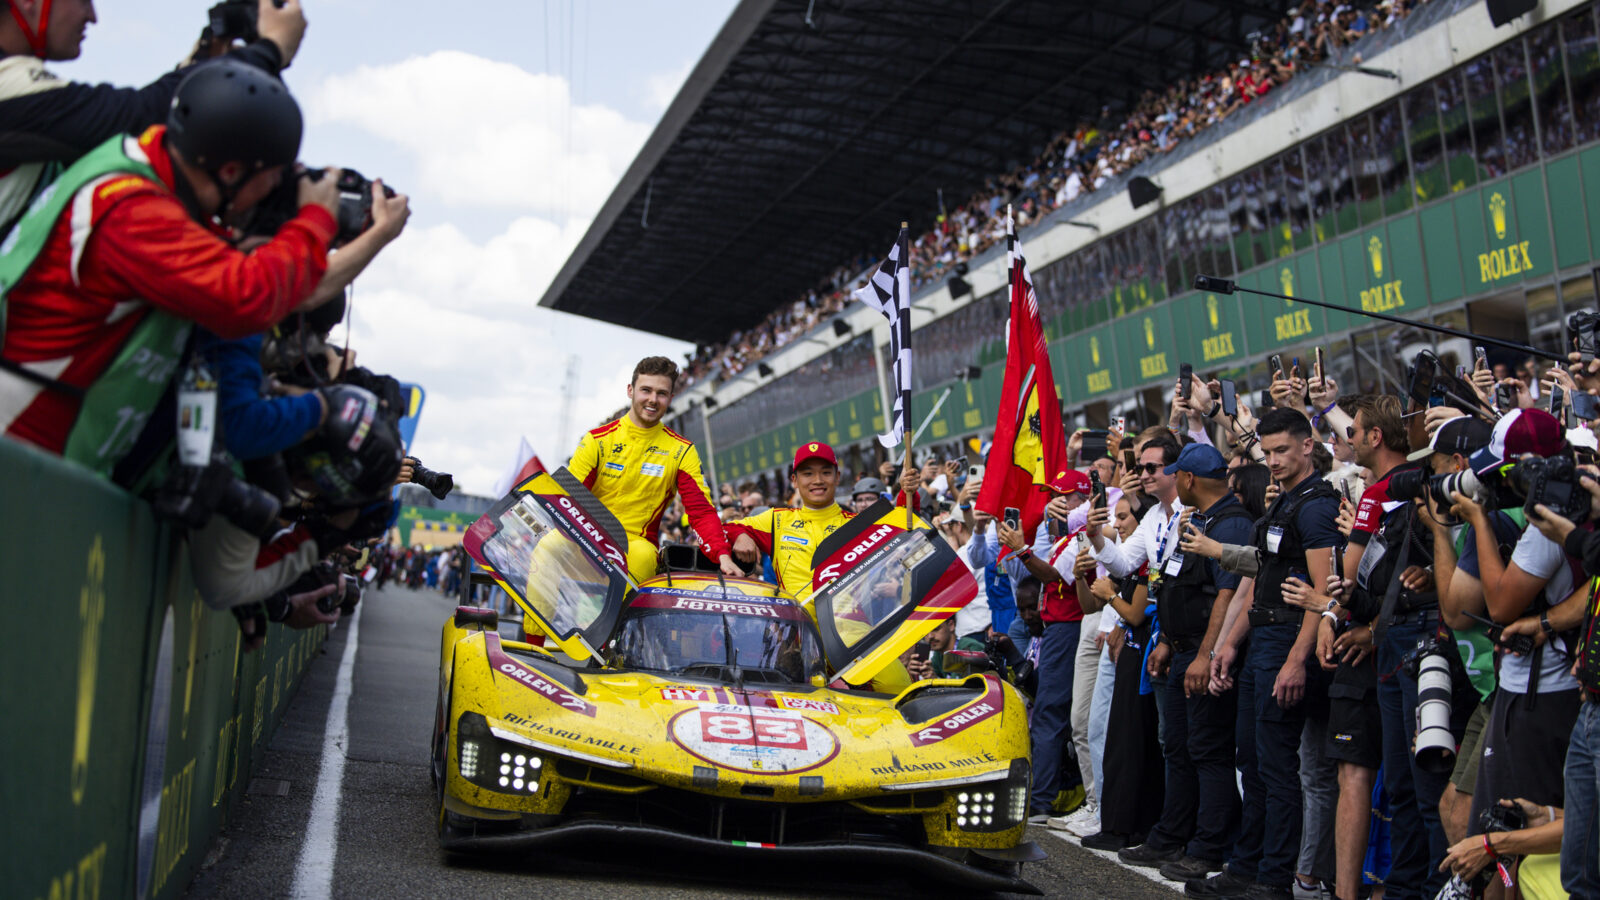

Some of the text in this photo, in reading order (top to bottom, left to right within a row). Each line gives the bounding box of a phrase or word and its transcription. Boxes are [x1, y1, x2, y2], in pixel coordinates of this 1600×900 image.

[1479, 240, 1533, 282] ROLEX
[1360, 280, 1405, 316] ROLEX
[1274, 308, 1312, 341] ROLEX
[1202, 332, 1235, 361] ROLEX
[559, 497, 604, 542] ORLEN
[844, 524, 893, 562] ORLEN
[651, 588, 722, 599] CHARLES
[727, 595, 771, 603] POZZI
[672, 597, 780, 618] Ferrari
[501, 663, 558, 695] ORLEN
[662, 689, 703, 700] HY
[787, 701, 836, 713] CAR
[707, 716, 801, 744] 83
[944, 703, 995, 729] ORLEN
[503, 712, 642, 755] RICHARD MILLE
[871, 753, 997, 775] RICHARD MILLE
